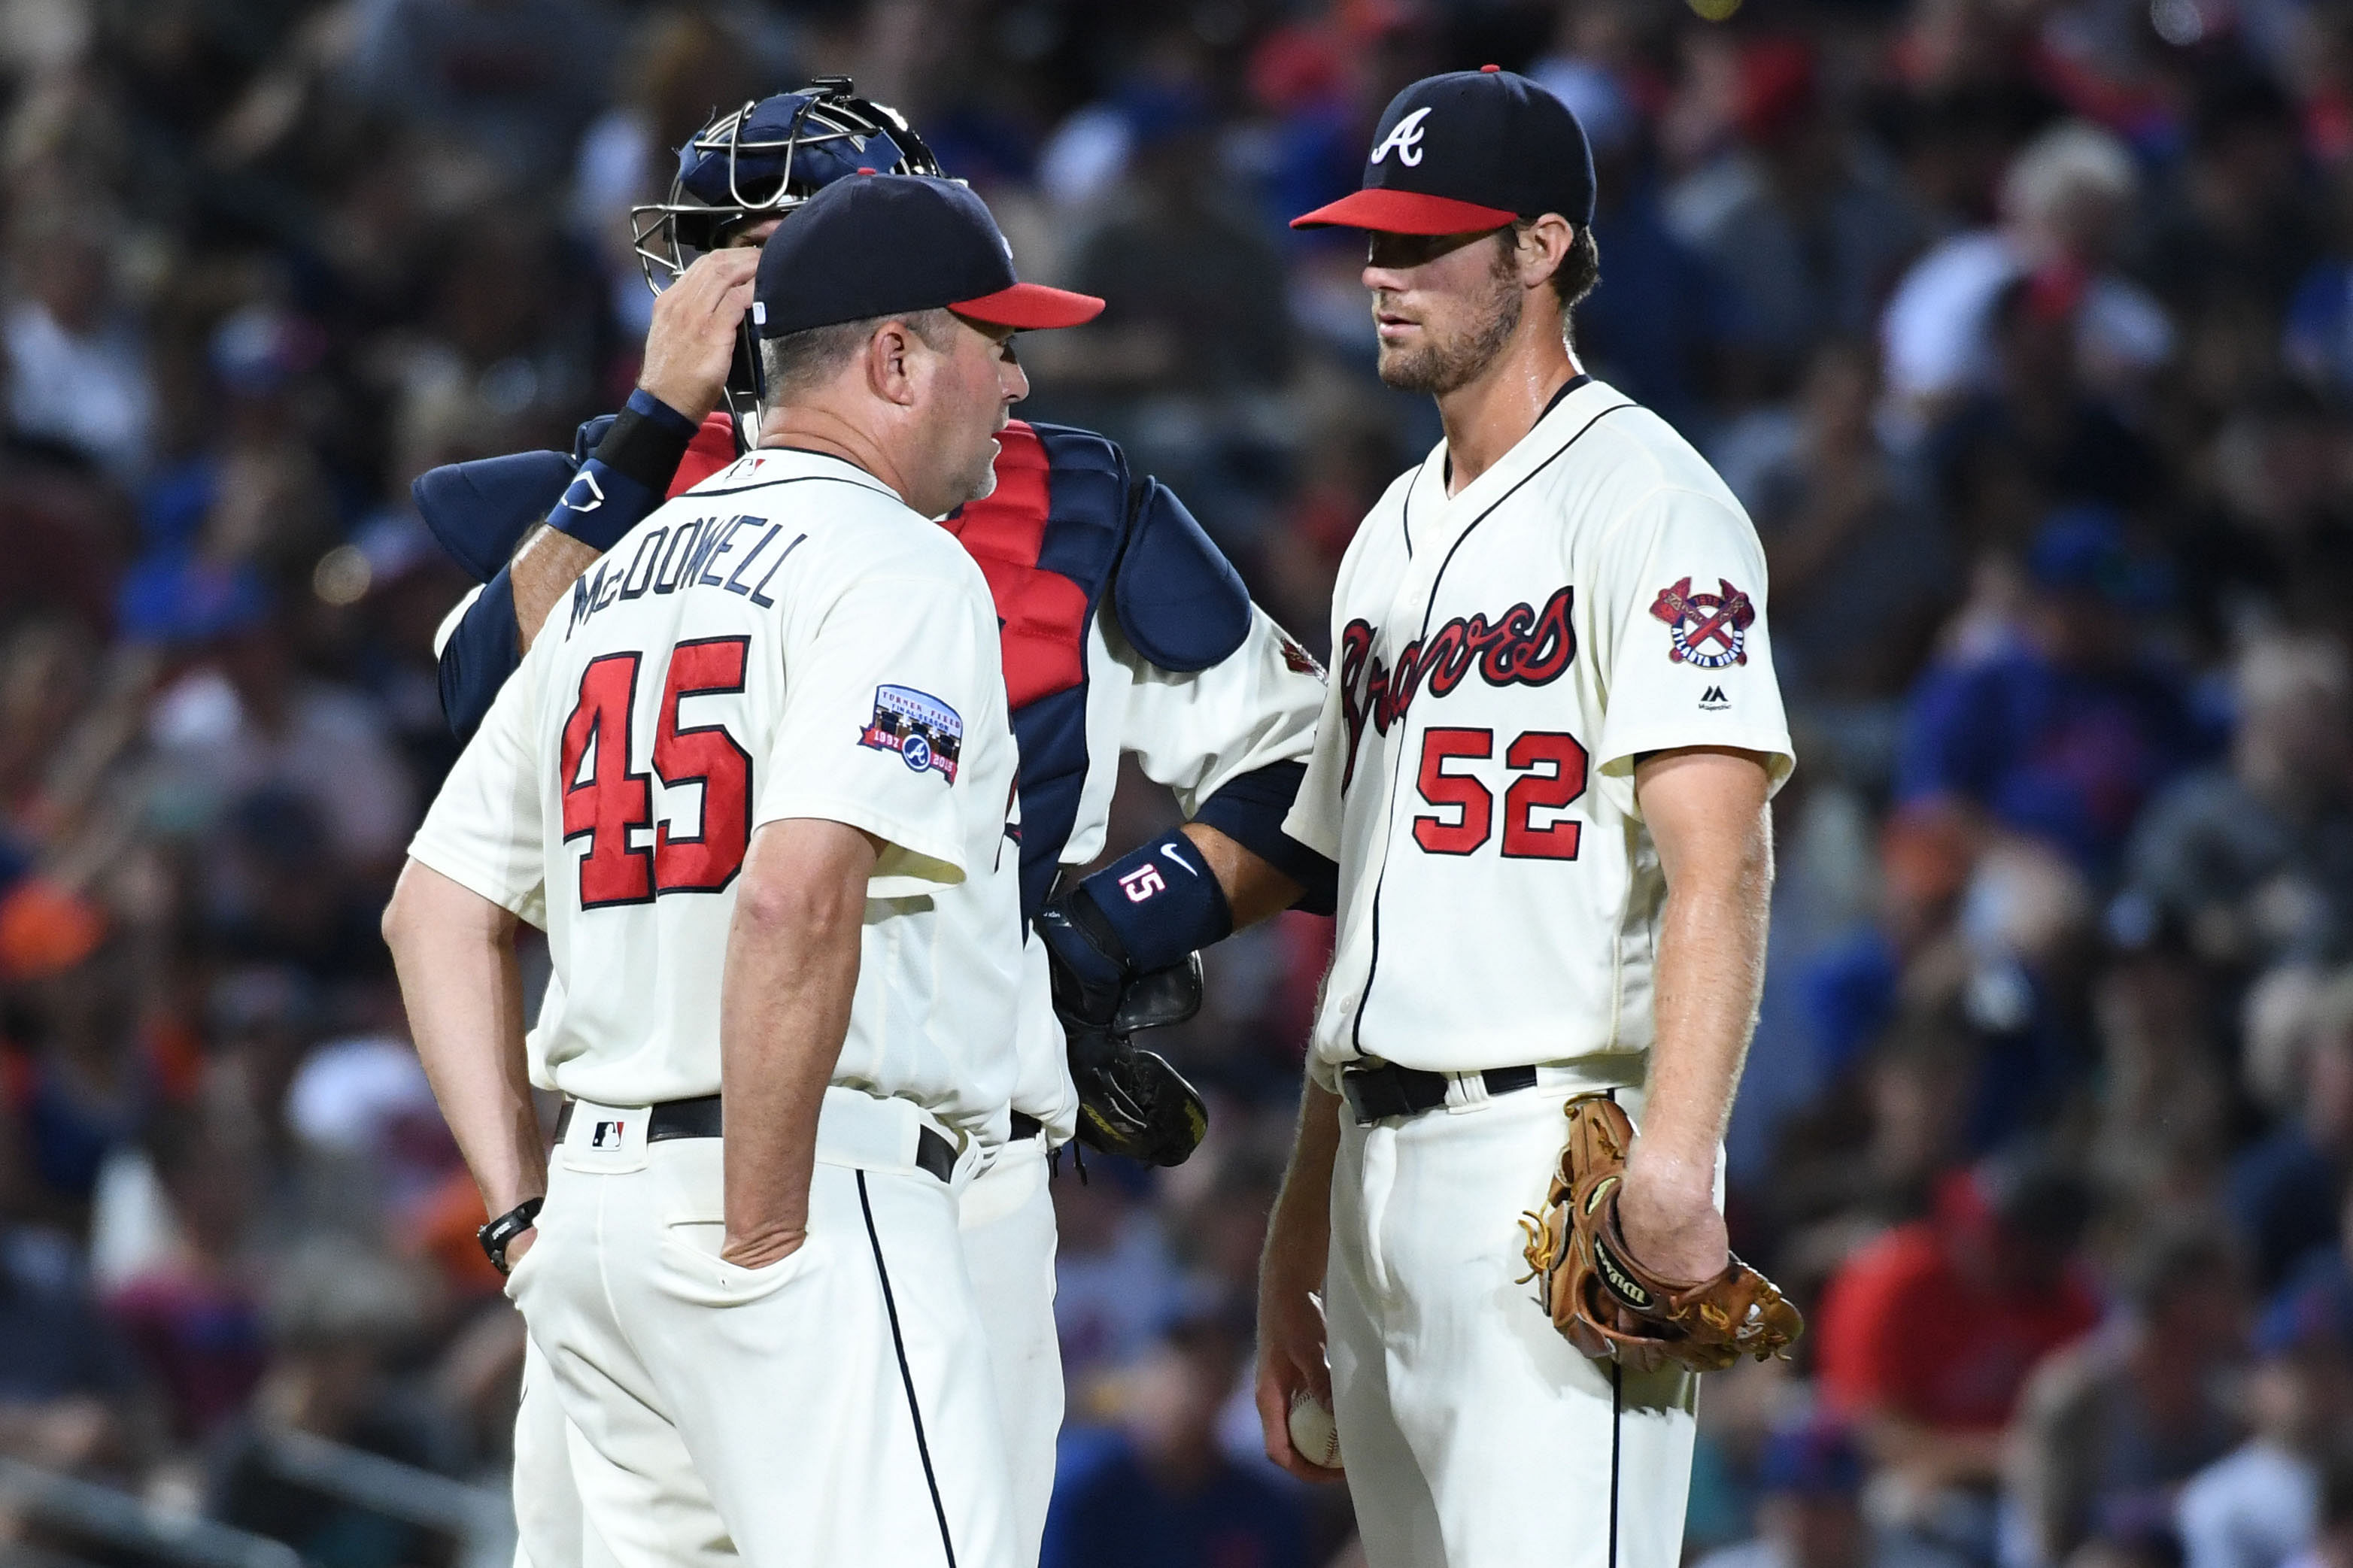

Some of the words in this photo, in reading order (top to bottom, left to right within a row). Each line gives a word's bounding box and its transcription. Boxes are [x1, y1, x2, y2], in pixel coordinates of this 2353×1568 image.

[1672, 627, 1711, 667] ATLANTA
[882, 690, 922, 712] TURNER
[892, 703, 915, 717] FINAL
[1340, 584, 1577, 800] Braves
[560, 635, 754, 911] 45
[1412, 726, 1589, 860] 52
[1118, 863, 1167, 902] 15
